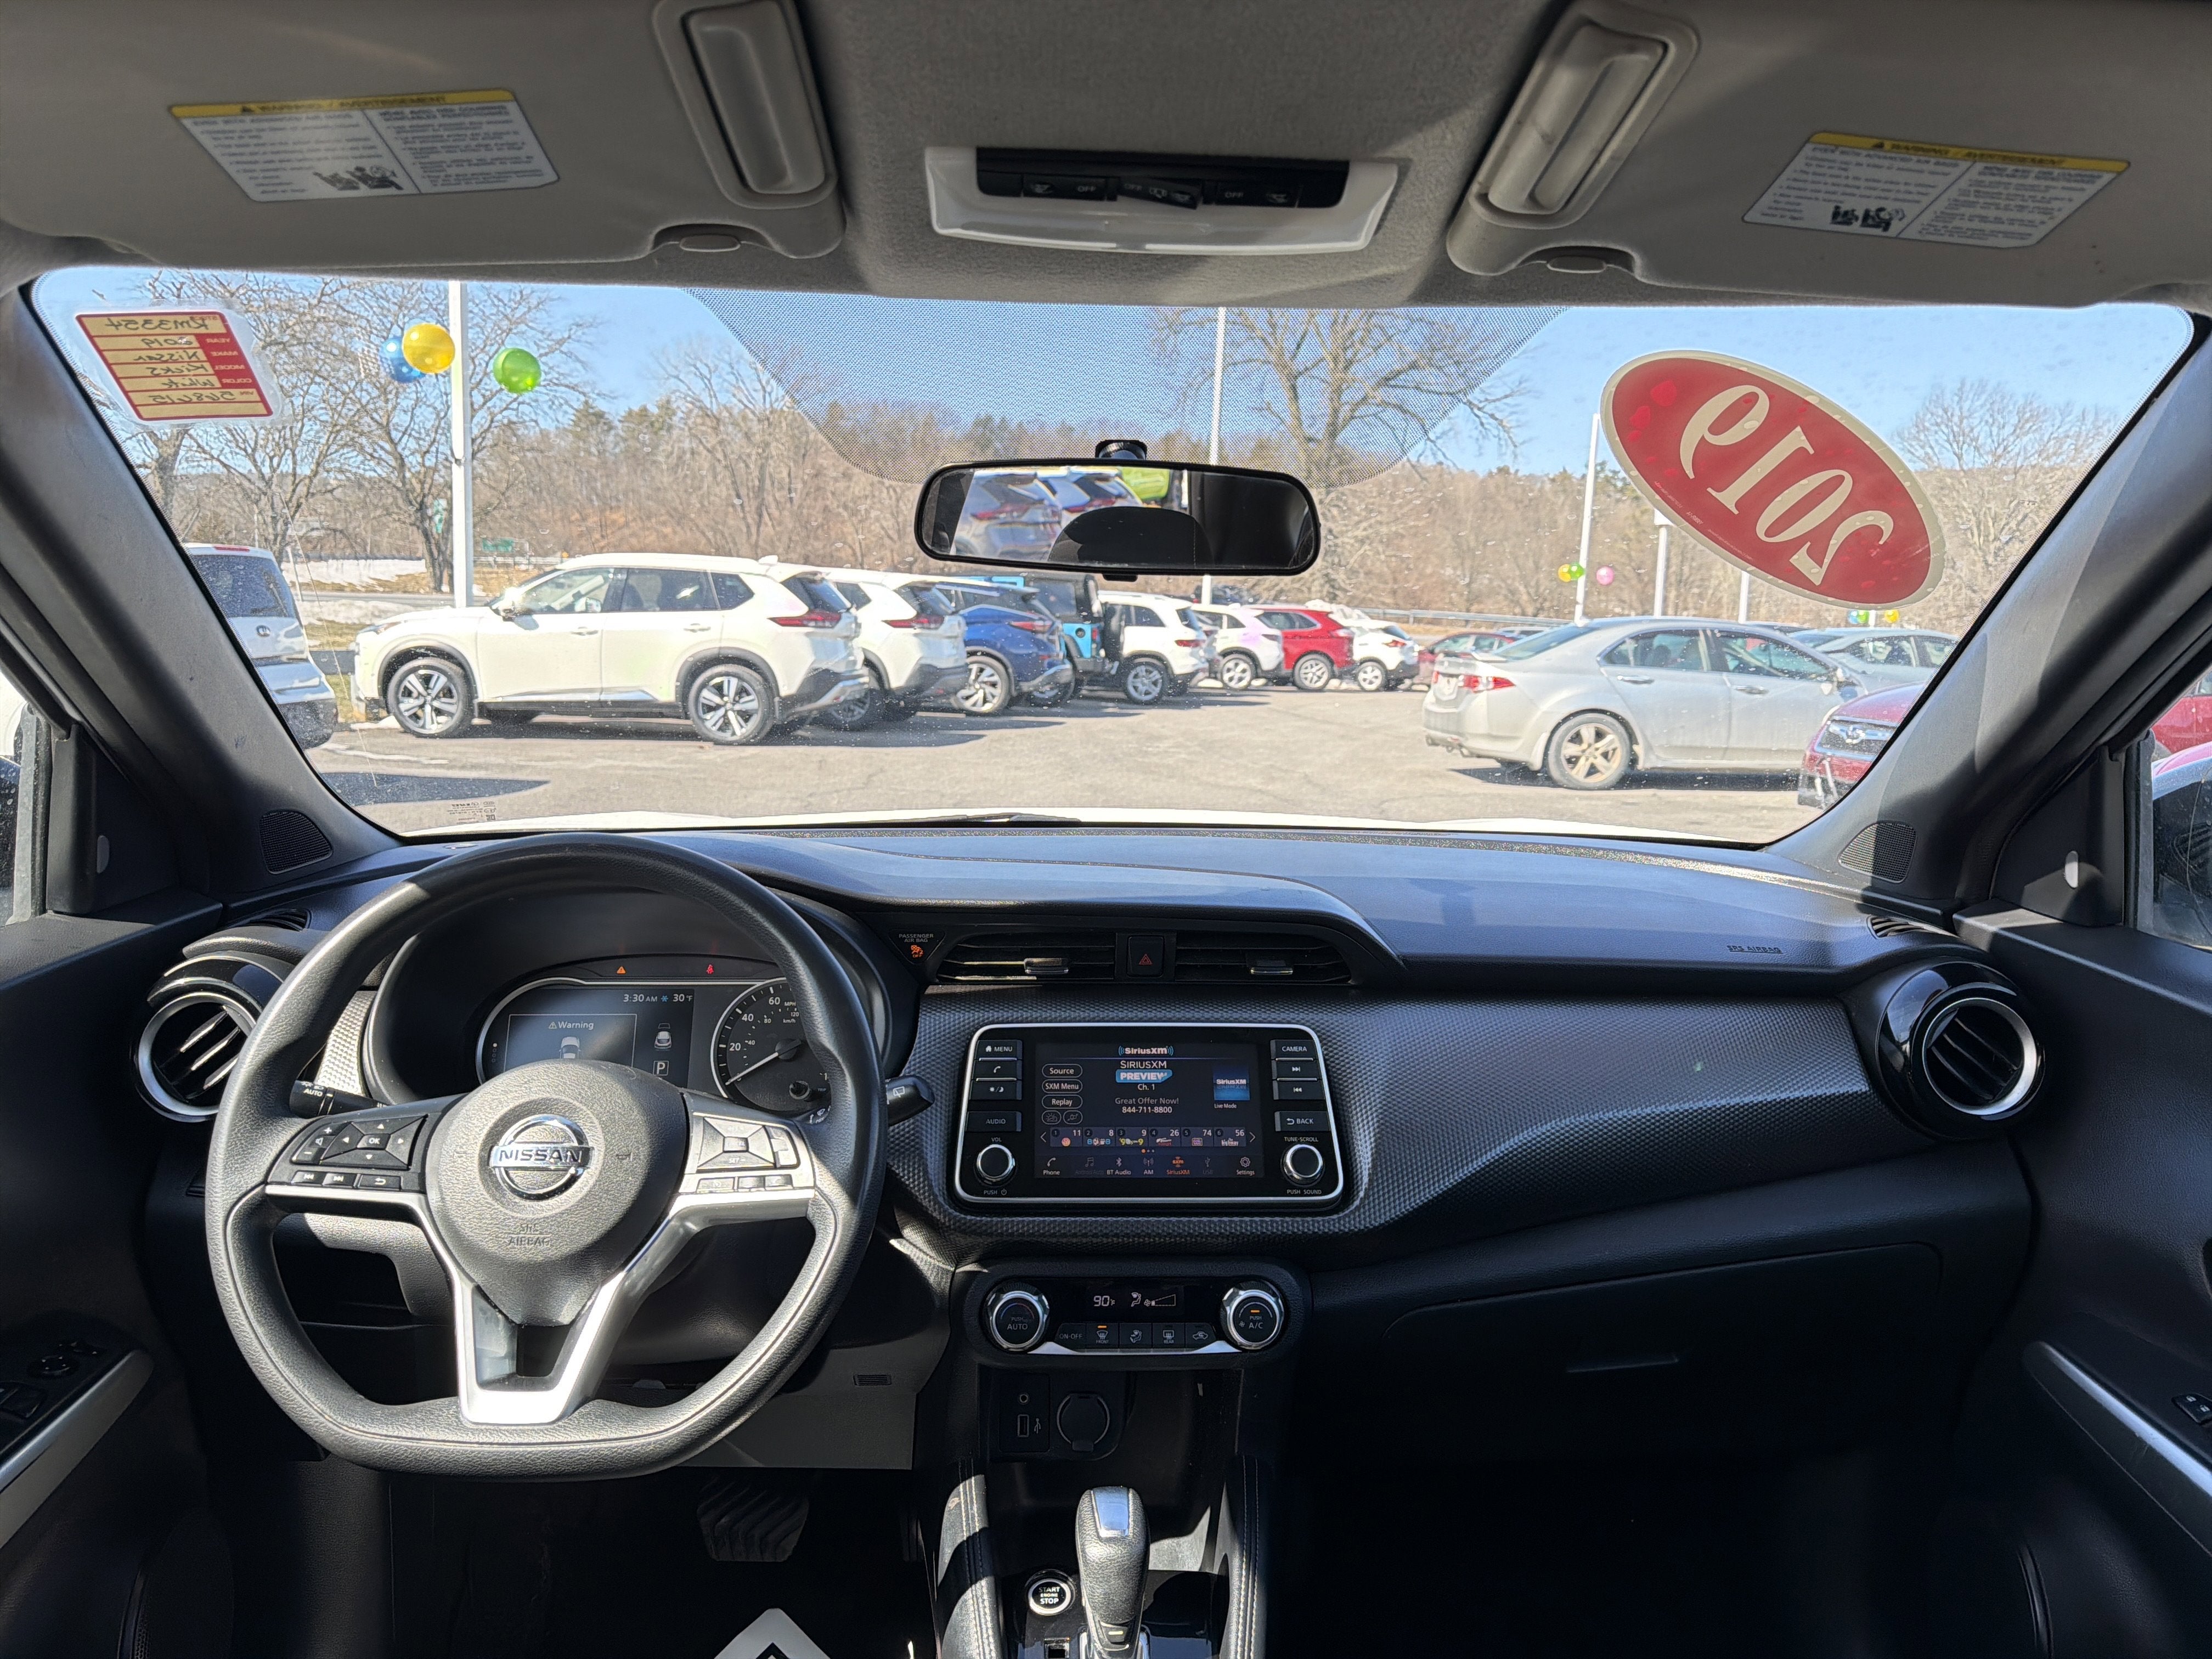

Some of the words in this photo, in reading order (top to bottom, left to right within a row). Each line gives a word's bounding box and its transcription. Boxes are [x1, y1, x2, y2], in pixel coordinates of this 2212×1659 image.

[623, 994, 645, 1002] 3:30
[558, 1021, 594, 1030] Warning
[729, 1043, 741, 1051] 20
[656, 1062, 665, 1074] P
[1120, 1072, 1167, 1080] PREVIEW
[304, 1088, 323, 1097] AUTO
[1052, 1098, 1073, 1107] Replay
[499, 1149, 583, 1163] NISSAN
